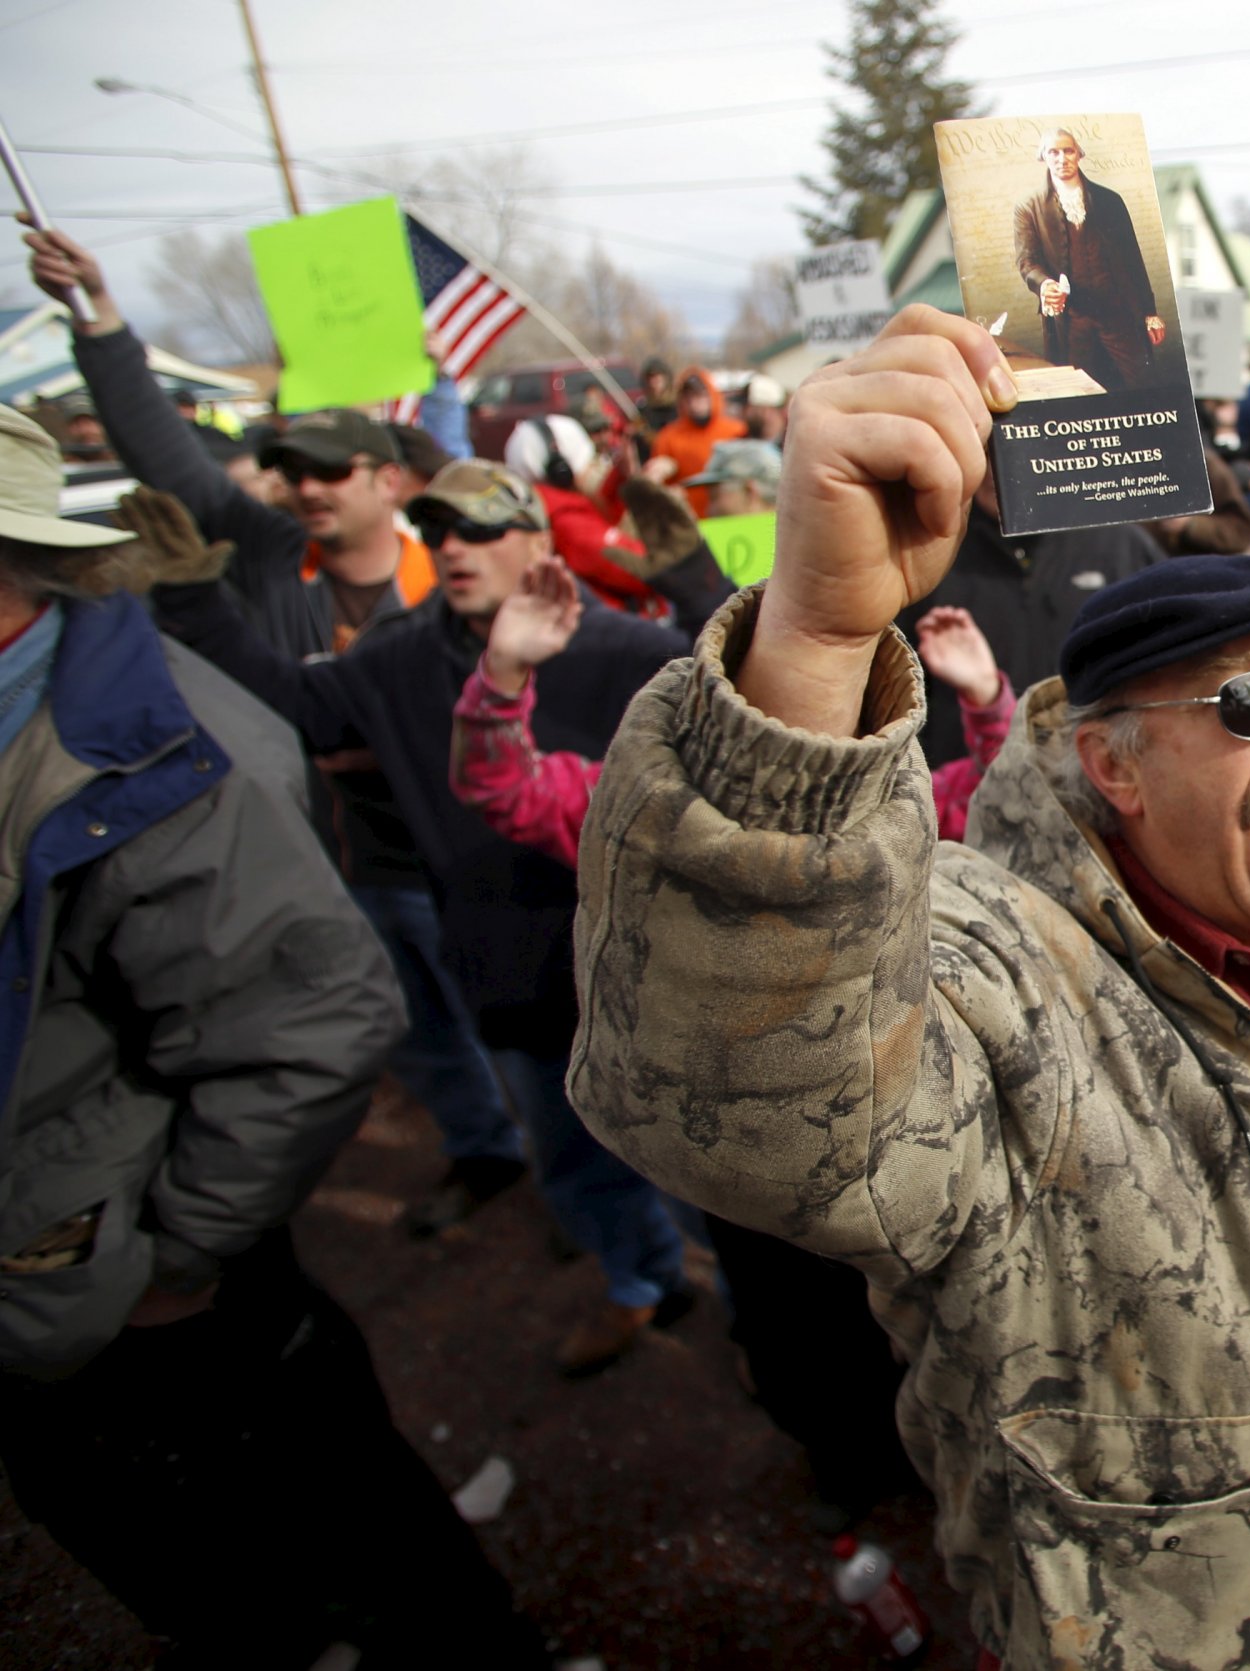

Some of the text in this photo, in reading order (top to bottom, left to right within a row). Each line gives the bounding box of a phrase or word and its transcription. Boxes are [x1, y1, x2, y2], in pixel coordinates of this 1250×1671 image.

[1001, 410, 1178, 440] THE CONSTITUTION
[1067, 436, 1121, 452] OF THE
[1030, 448, 1163, 474] UNITED STATES
[1059, 481, 1079, 495] only
[1081, 477, 1119, 494] keepers,
[1121, 475, 1136, 487] the
[1137, 471, 1170, 488] people.
[1127, 483, 1179, 499] Washington
